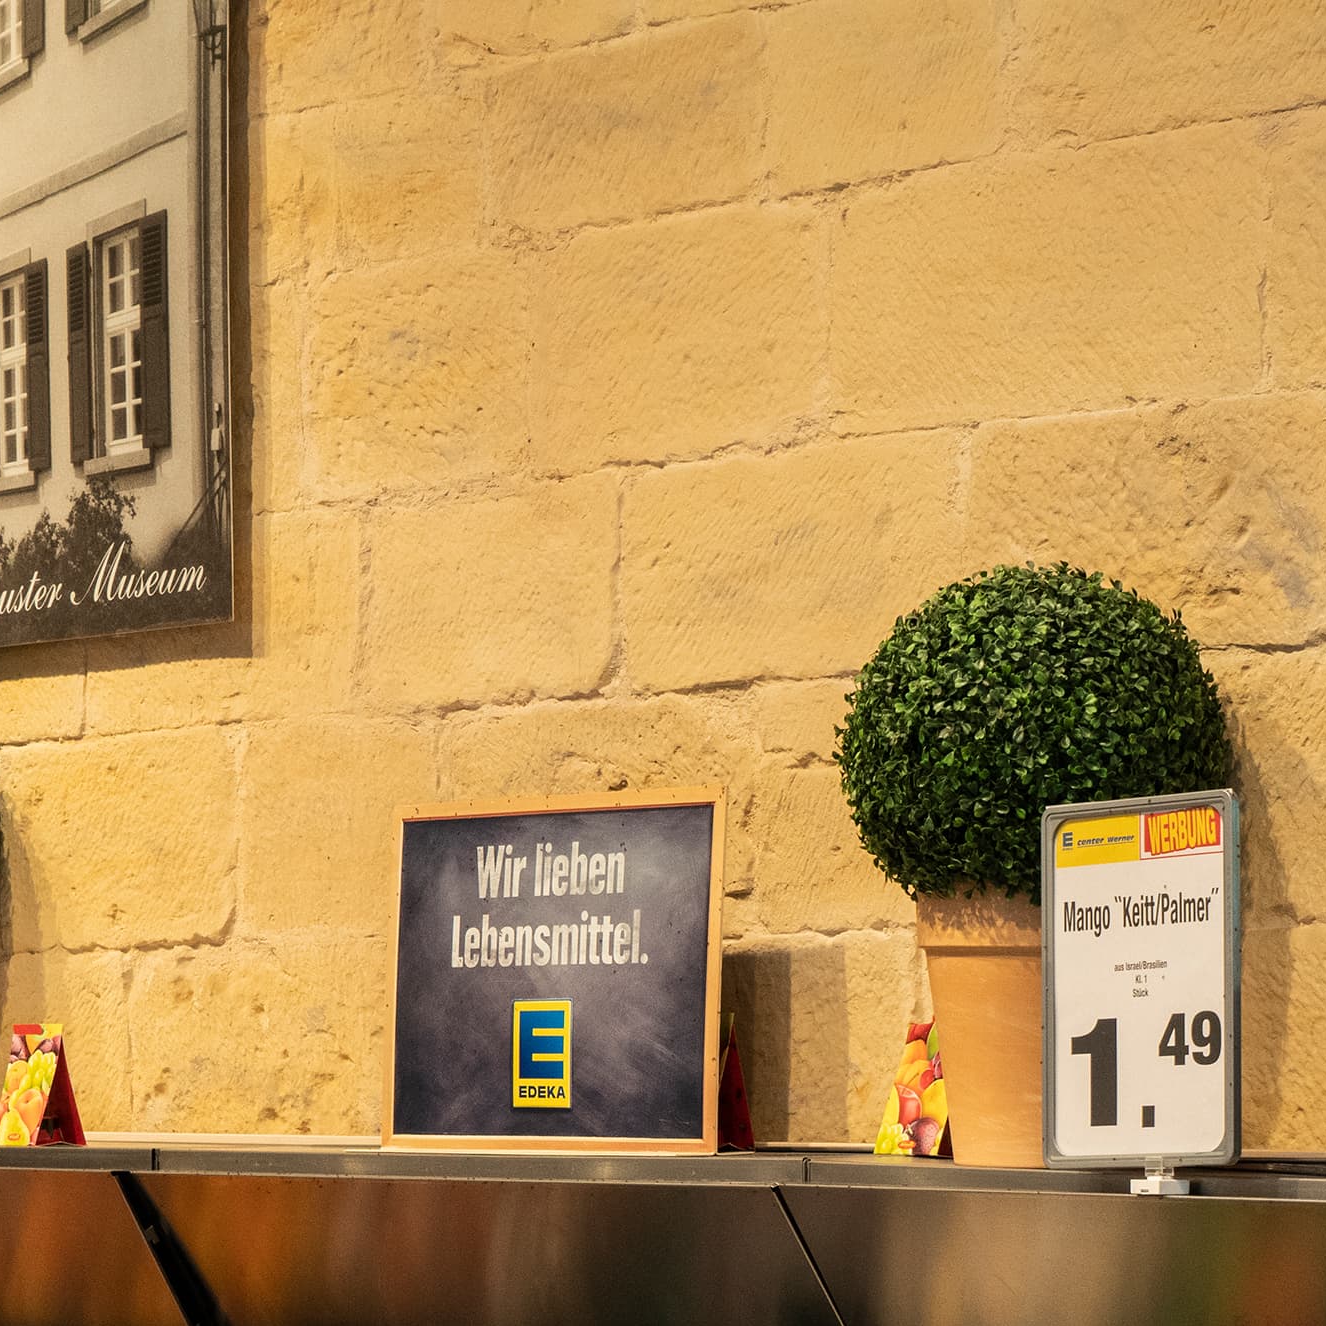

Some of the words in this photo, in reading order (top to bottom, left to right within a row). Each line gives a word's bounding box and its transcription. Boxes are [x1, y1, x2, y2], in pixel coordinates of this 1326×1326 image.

[71, 541, 207, 606] Museum
[1148, 807, 1217, 856] WERBUNG
[477, 844, 527, 899] Wir
[534, 841, 625, 897] lieben
[451, 909, 648, 969] Lebensmittel.
[1064, 901, 1110, 938] Mango
[519, 1010, 565, 1079] E
[519, 1086, 566, 1099] EDEKA
